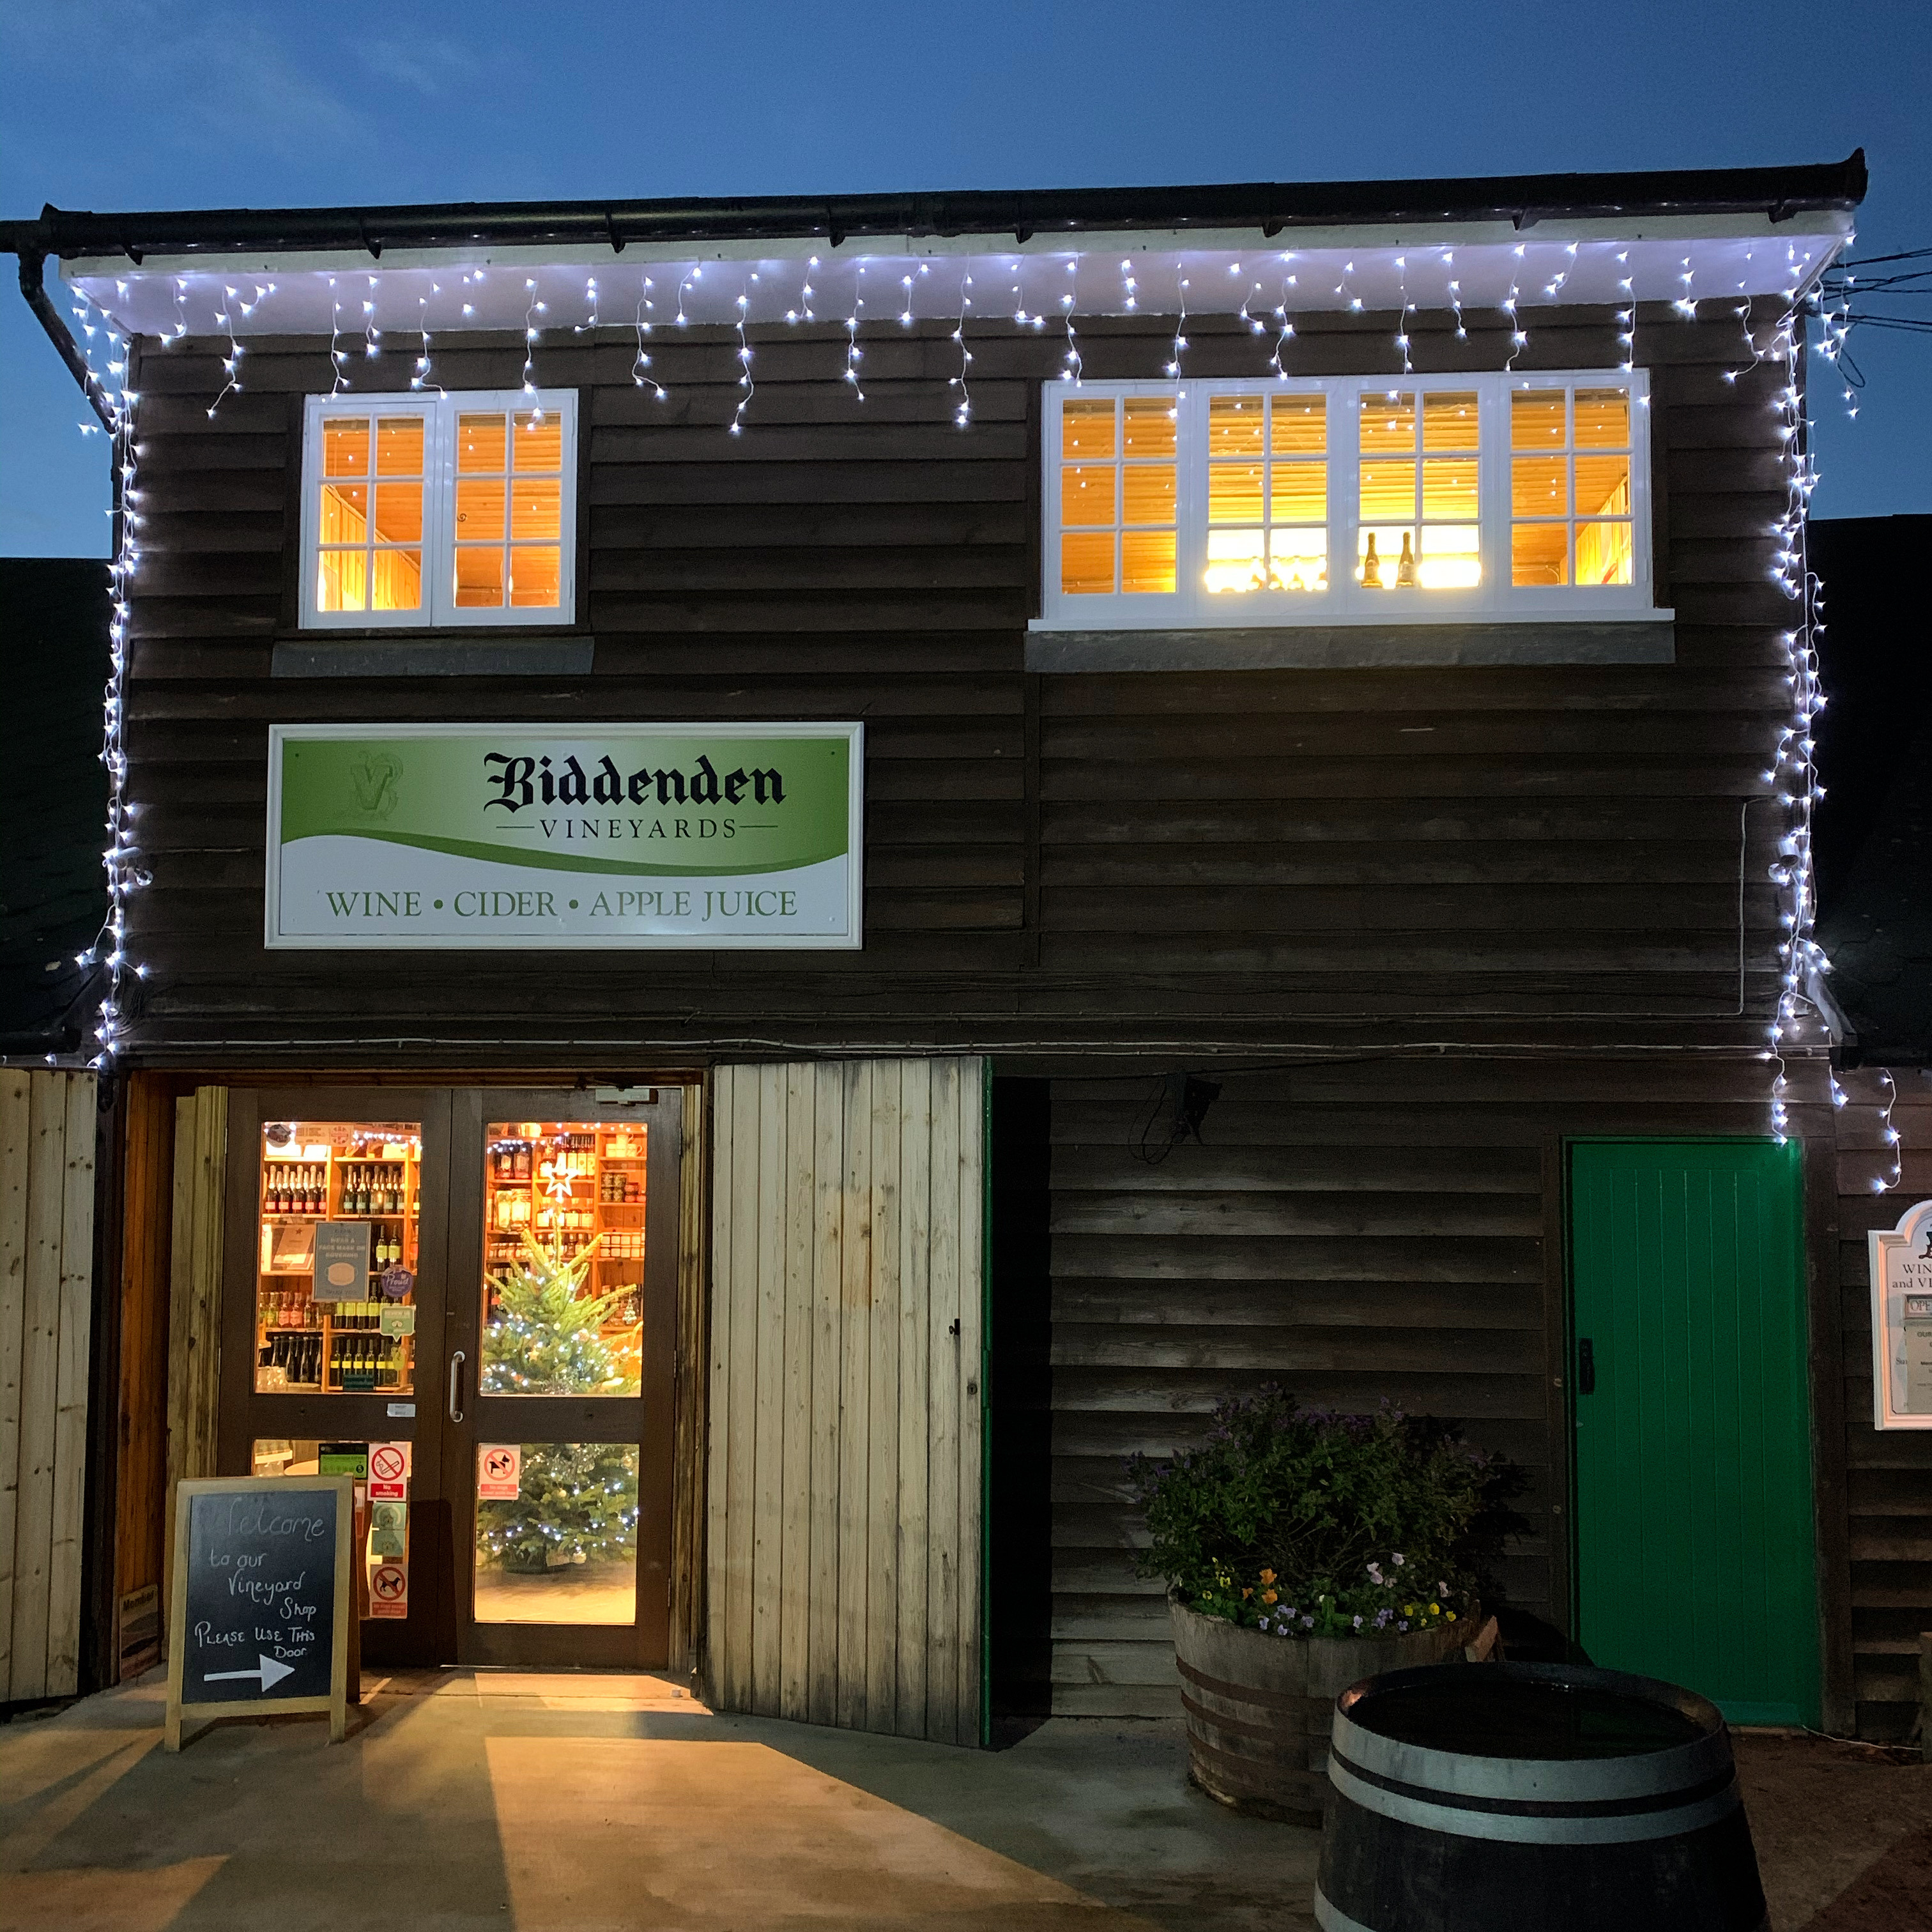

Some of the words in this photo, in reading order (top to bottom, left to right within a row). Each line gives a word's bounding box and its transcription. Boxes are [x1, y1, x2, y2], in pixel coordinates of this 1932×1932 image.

[484, 753, 786, 813] Biddenden
[540, 818, 736, 839] VINEYARDS
[325, 891, 422, 917] WINE
[454, 891, 558, 917] CIDER
[588, 891, 692, 917] APPLE
[702, 891, 797, 922] JUICE
[387, 1274, 409, 1286] Proud
[1892, 1278, 1913, 1288] and
[209, 1547, 229, 1566] to
[237, 1553, 269, 1567] our
[228, 1568, 305, 1606] Vineyard
[280, 1597, 317, 1622] Shop
